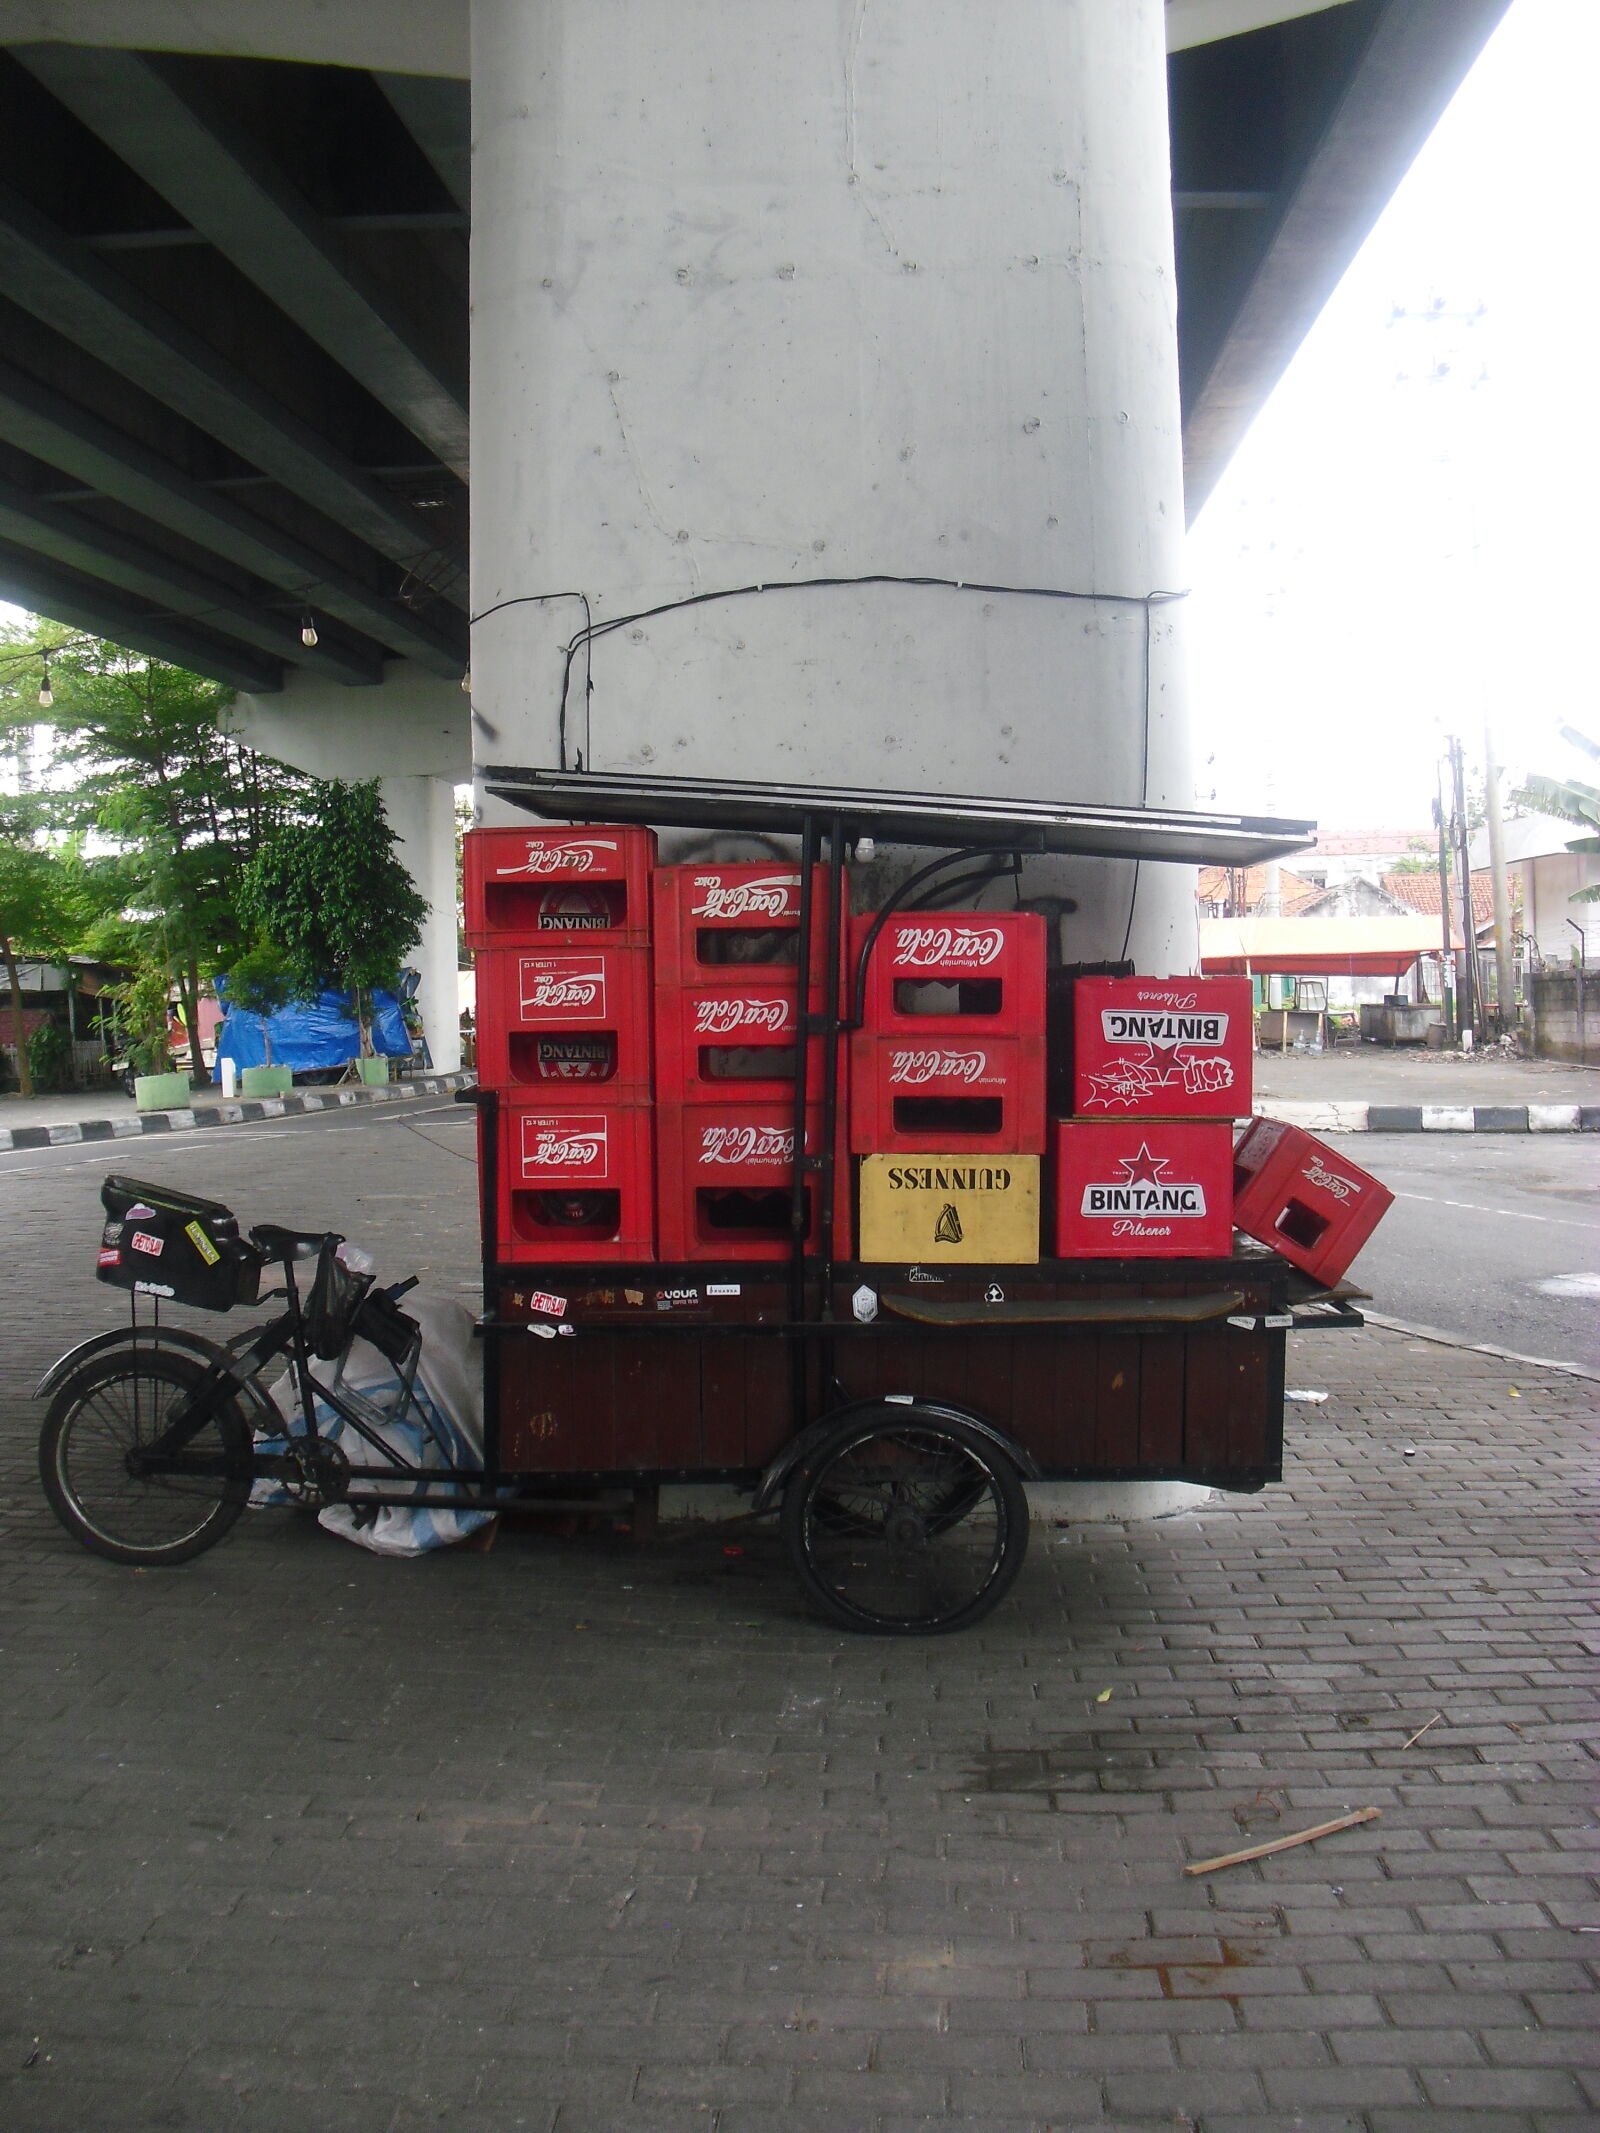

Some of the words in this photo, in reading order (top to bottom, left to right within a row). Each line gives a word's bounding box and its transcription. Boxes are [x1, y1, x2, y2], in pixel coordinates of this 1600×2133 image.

[526, 850, 593, 873] Coca-Cola
[703, 888, 788, 918] Coca-Cola
[893, 928, 1003, 965] Coca-Cola
[534, 984, 596, 1006] Coca-Cola
[1137, 991, 1197, 1009] Pilsener
[693, 1000, 789, 1032] Coca-Cola
[1108, 1016, 1219, 1040] BINTANG
[542, 1044, 606, 1058] BINTANG
[889, 1050, 986, 1083] Coca-Cola
[536, 1142, 598, 1164] Coca-Cola
[888, 1168, 1010, 1190] GUINNESS
[1090, 1190, 1197, 1210] BINTANG
[1112, 1219, 1171, 1236] Pilsener
